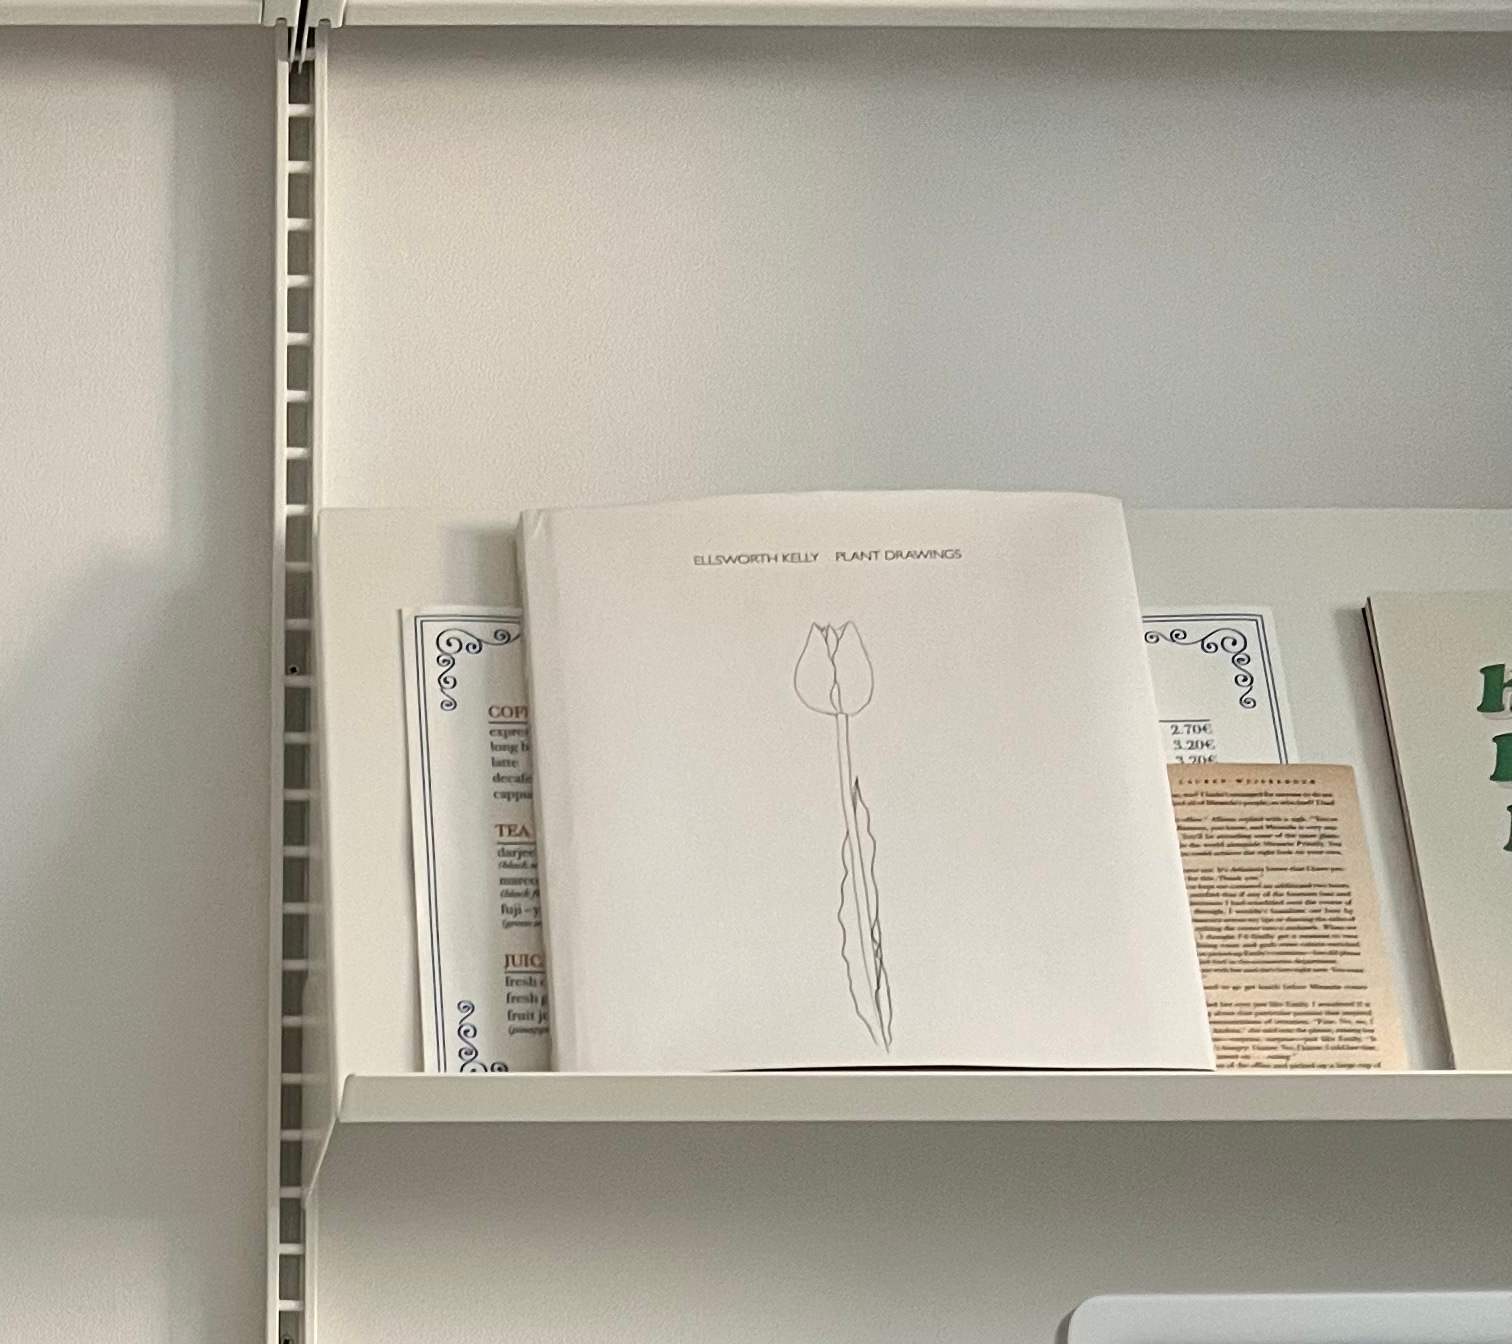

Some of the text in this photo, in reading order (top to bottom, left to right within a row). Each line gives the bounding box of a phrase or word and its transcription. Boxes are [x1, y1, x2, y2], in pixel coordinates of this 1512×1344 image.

[694, 552, 819, 566] ELLSWORTH KELLY
[835, 548, 963, 562] PLANT DRAWINGS
[494, 823, 532, 838] TEA
[501, 903, 522, 918] fuji
